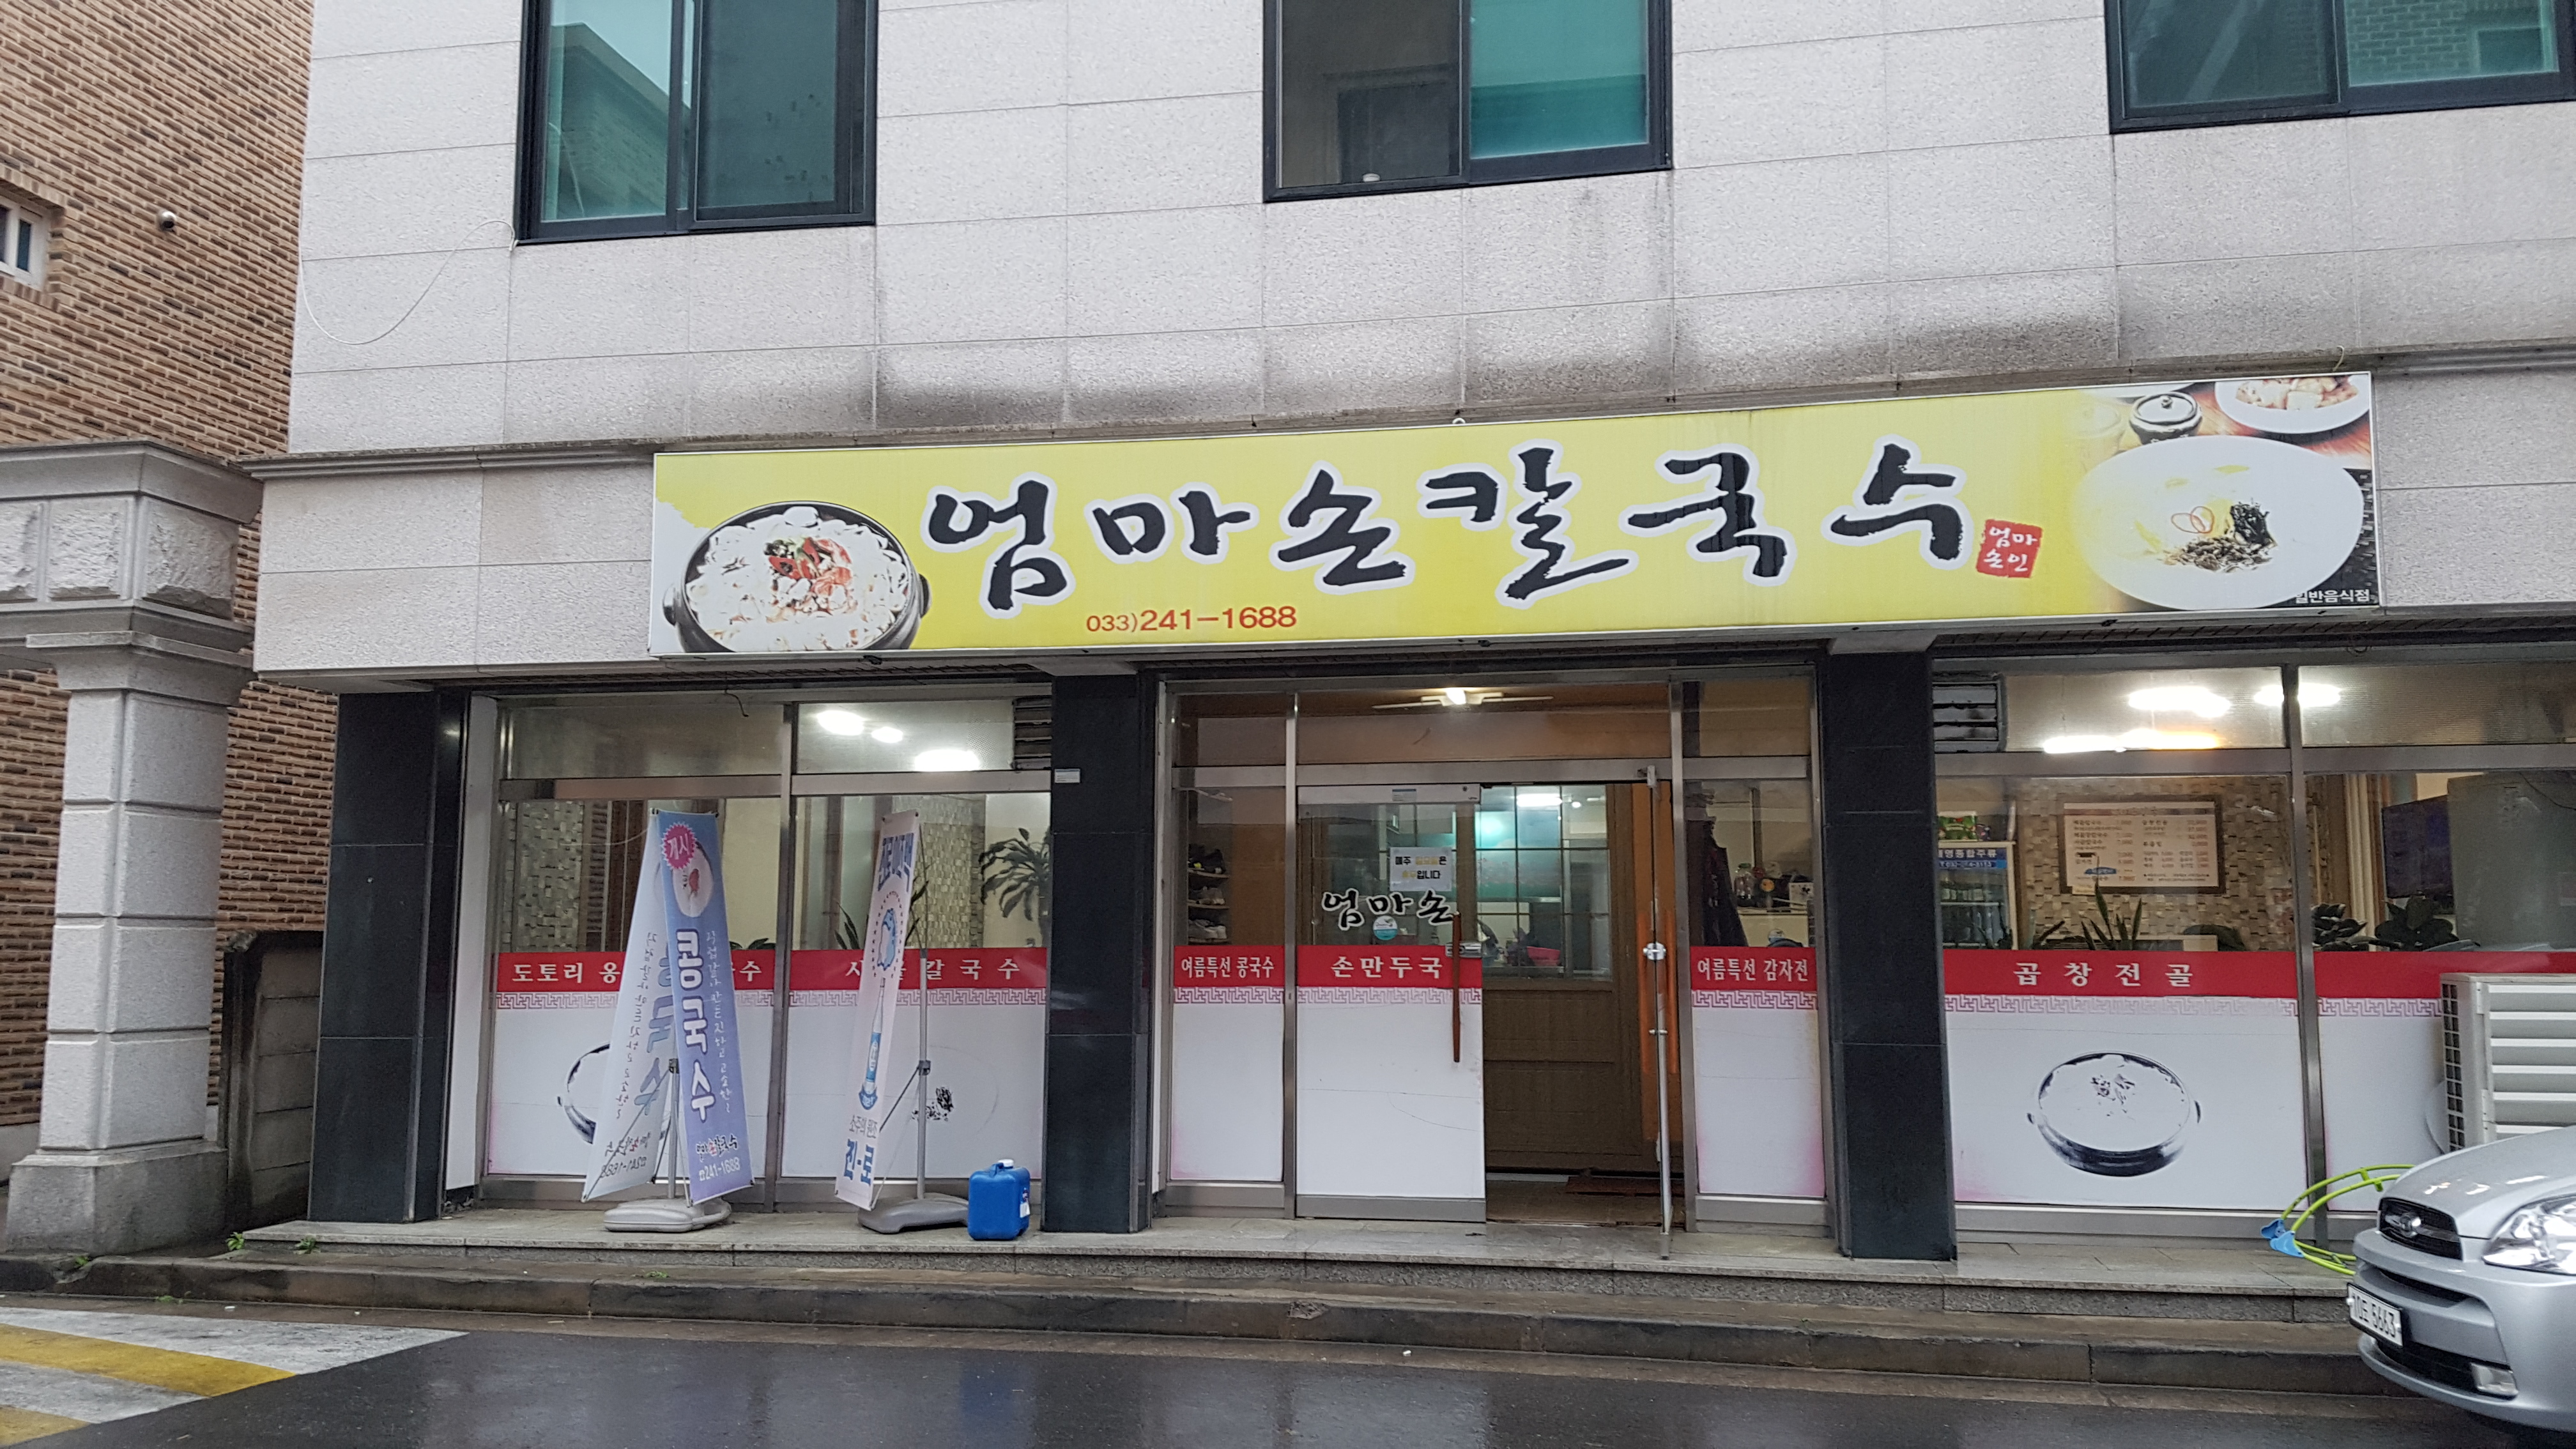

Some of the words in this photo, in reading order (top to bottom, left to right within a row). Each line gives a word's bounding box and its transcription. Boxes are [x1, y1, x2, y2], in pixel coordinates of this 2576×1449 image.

[1989, 526, 2038, 548] 엄마
[2295, 588, 2370, 604] 일반음식점
[1323, 889, 1453, 930] 엄마손
[512, 962, 583, 983] 도토리
[1181, 956, 1231, 979] 여름특선
[1236, 956, 1275, 979] 콩국수
[1330, 956, 1443, 979] 손만두국
[1697, 958, 1756, 981] 여름특선
[1763, 958, 1808, 982] 감자전
[2012, 962, 2193, 987] 곱창전골
[675, 929, 715, 1122] 콩국수
